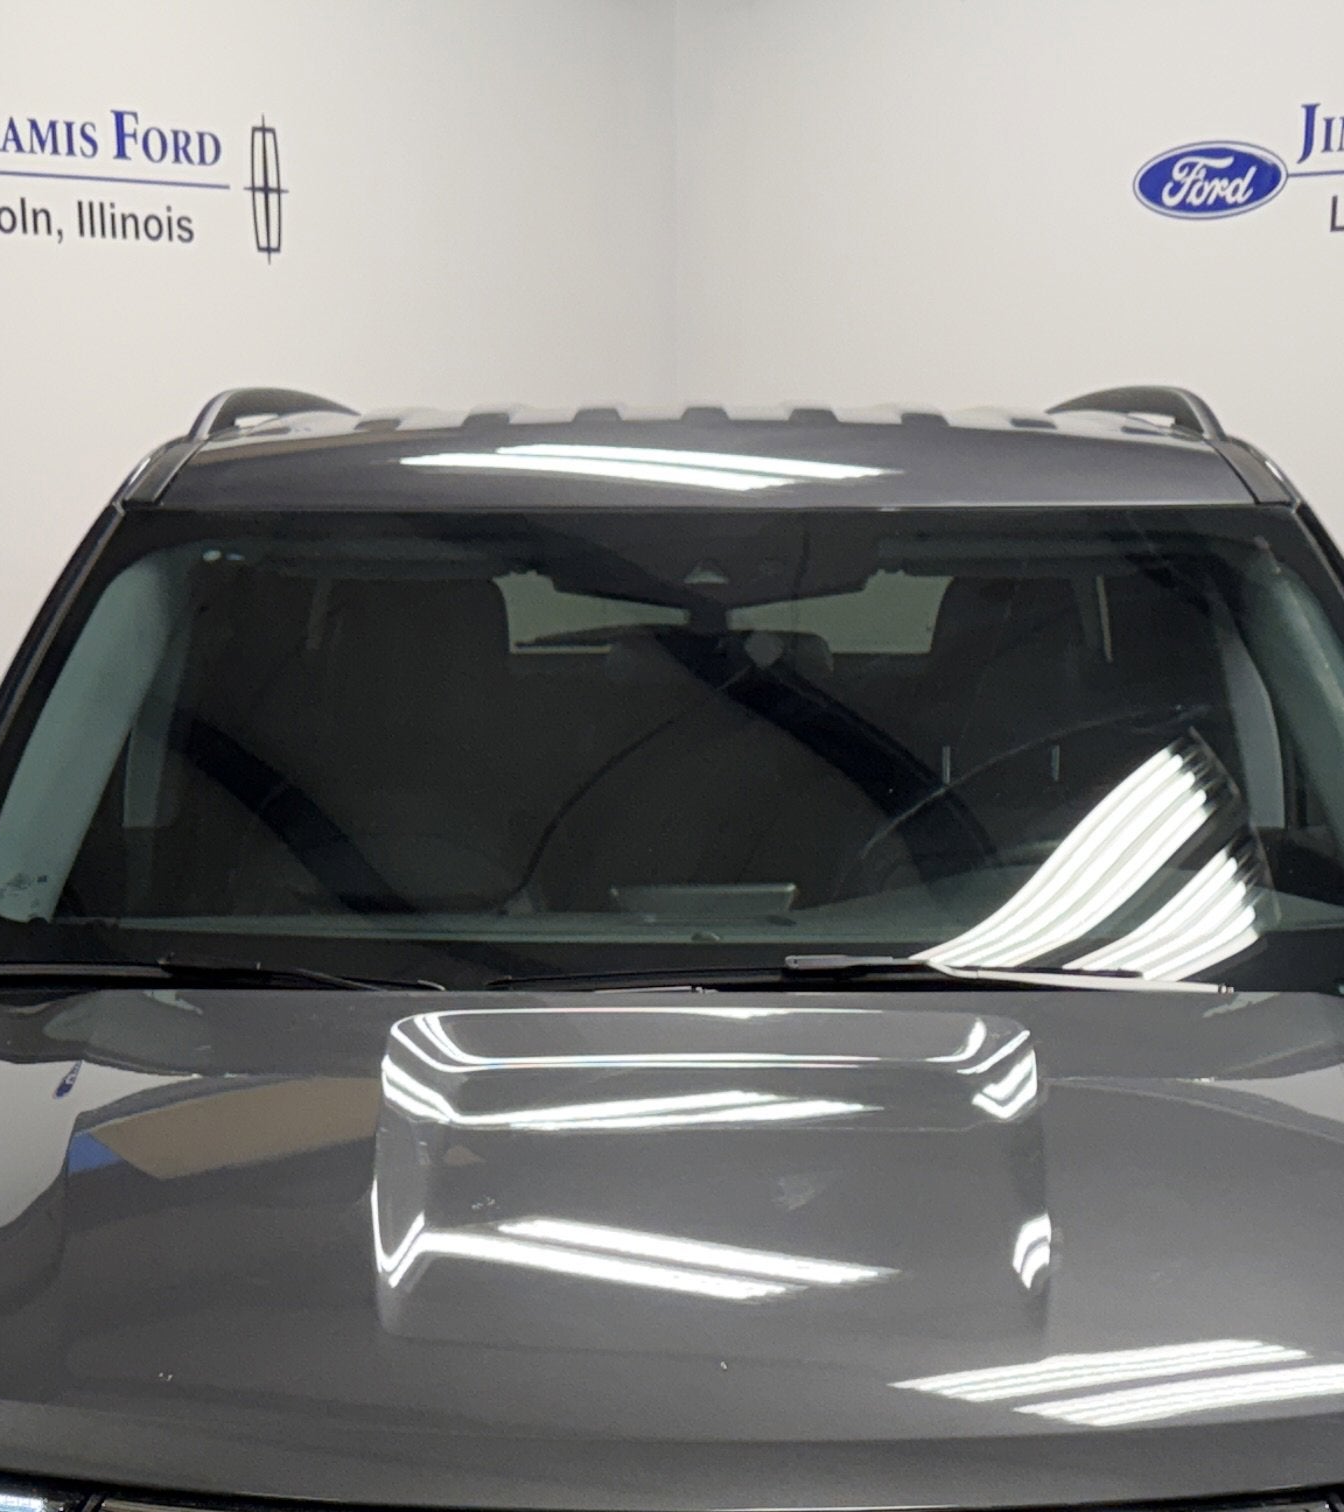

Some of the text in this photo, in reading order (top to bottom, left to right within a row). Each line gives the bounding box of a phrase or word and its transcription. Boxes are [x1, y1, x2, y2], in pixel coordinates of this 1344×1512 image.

[110, 109, 223, 166] FORD
[1161, 155, 1256, 206] Ford
[76, 199, 195, 244] Illinois
